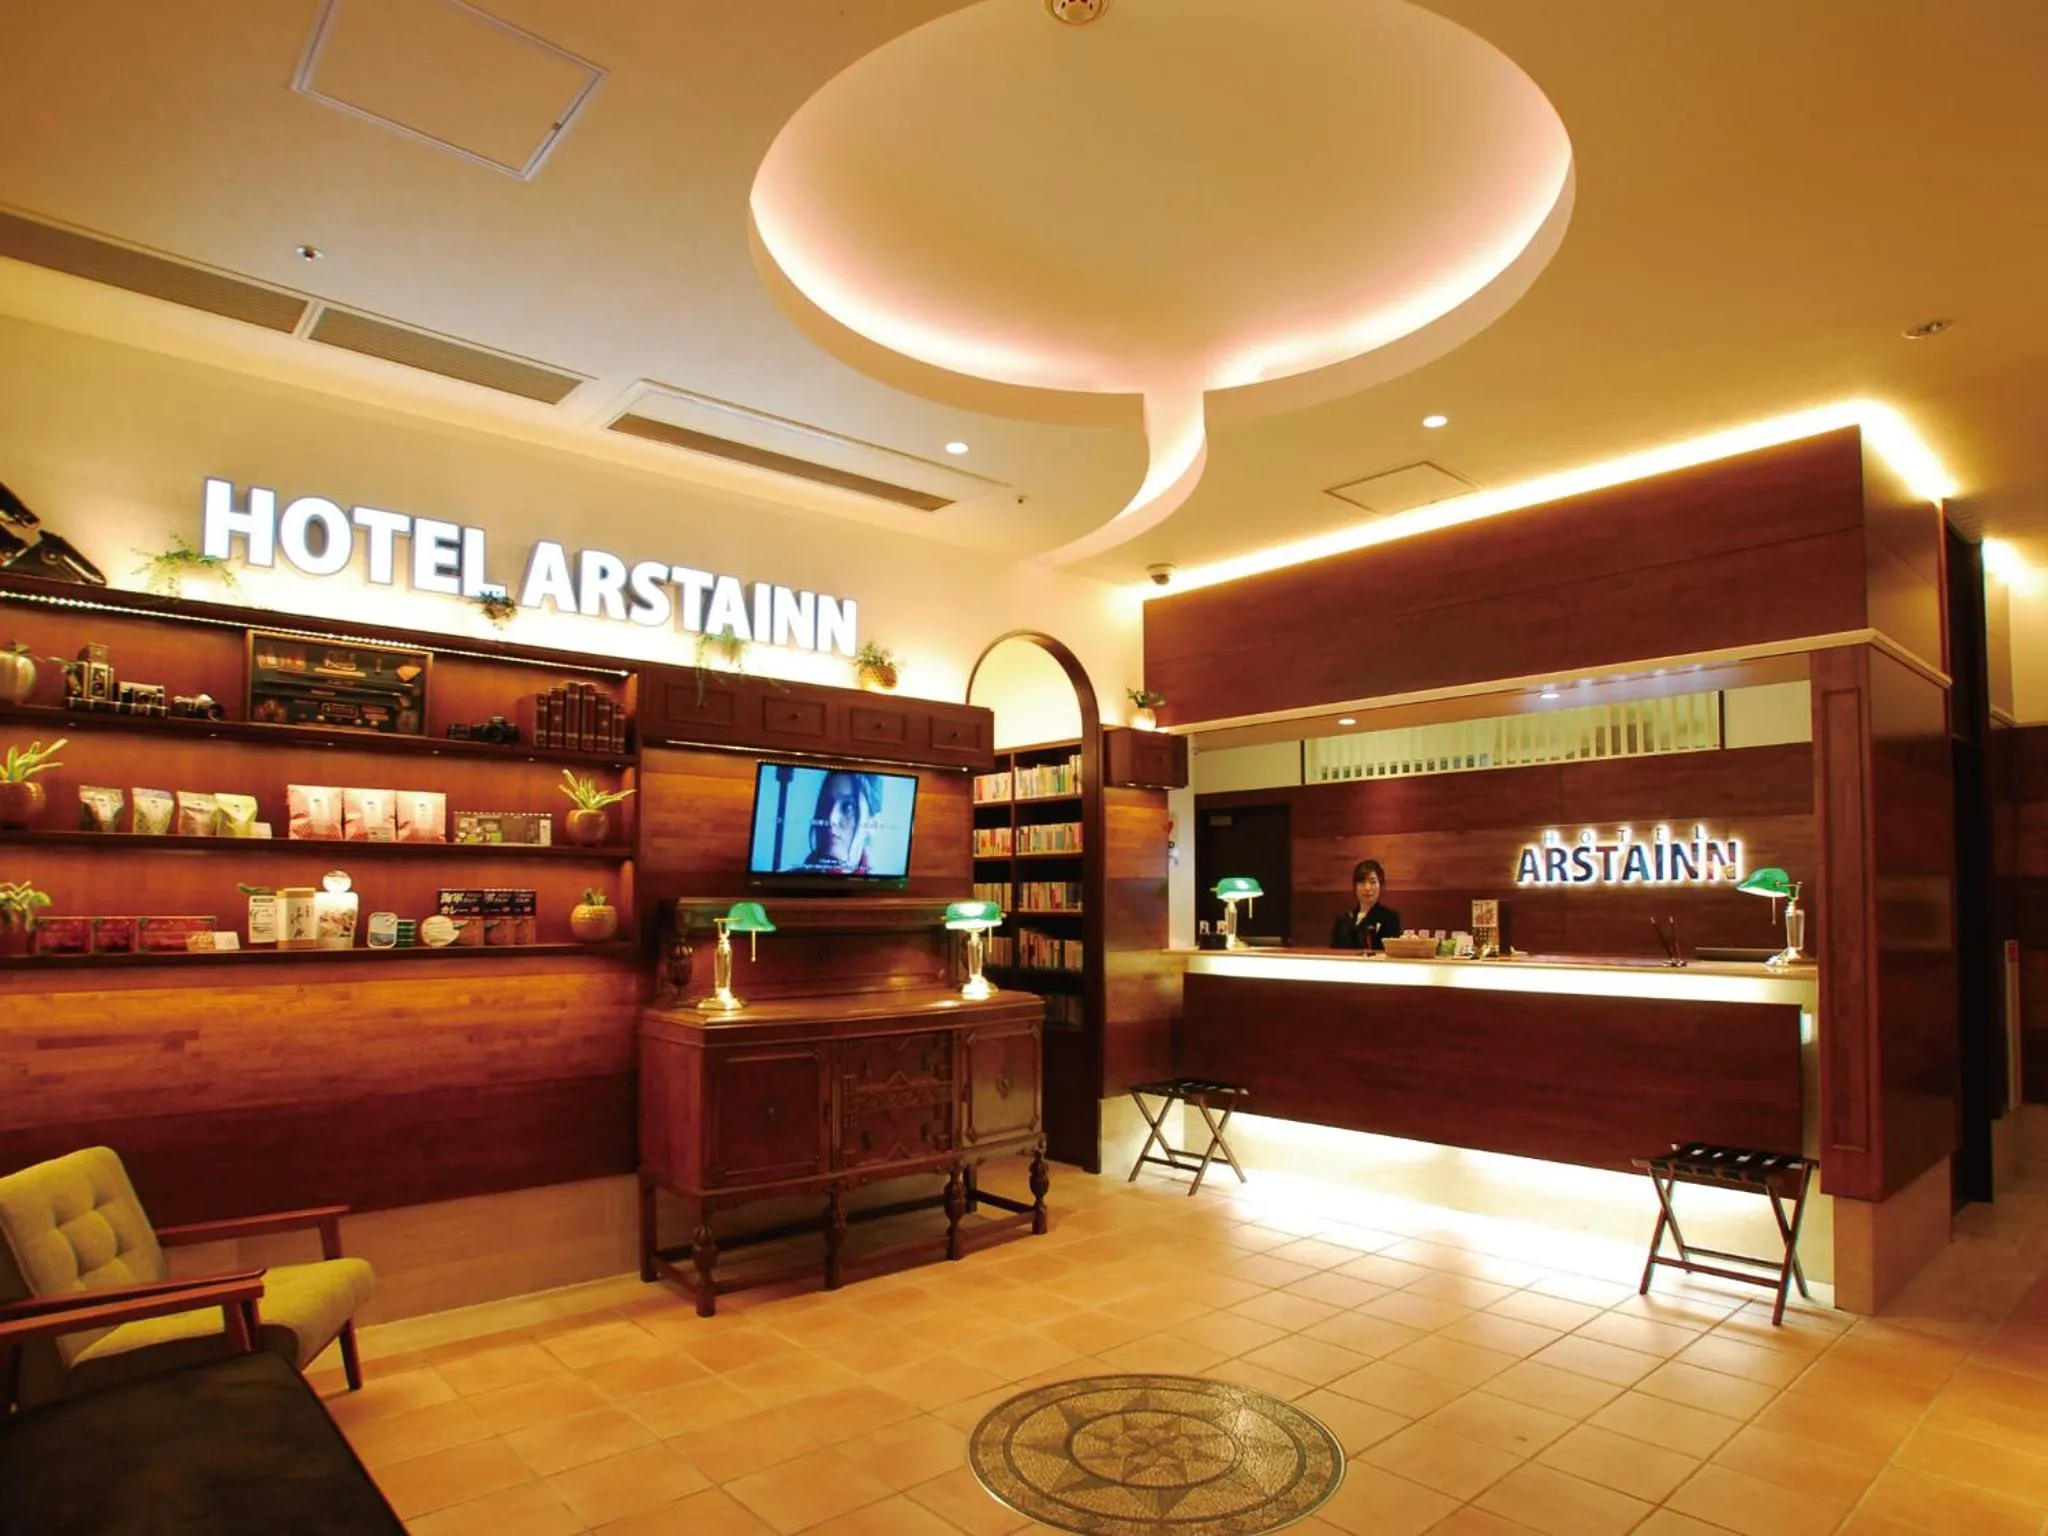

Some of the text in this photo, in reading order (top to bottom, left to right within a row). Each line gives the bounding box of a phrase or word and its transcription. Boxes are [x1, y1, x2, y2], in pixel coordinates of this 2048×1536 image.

[203, 477, 859, 658] HOTEL ARSTAINN
[1543, 825, 1702, 843] HOTEL
[1516, 841, 1738, 882] ARSTAINN
